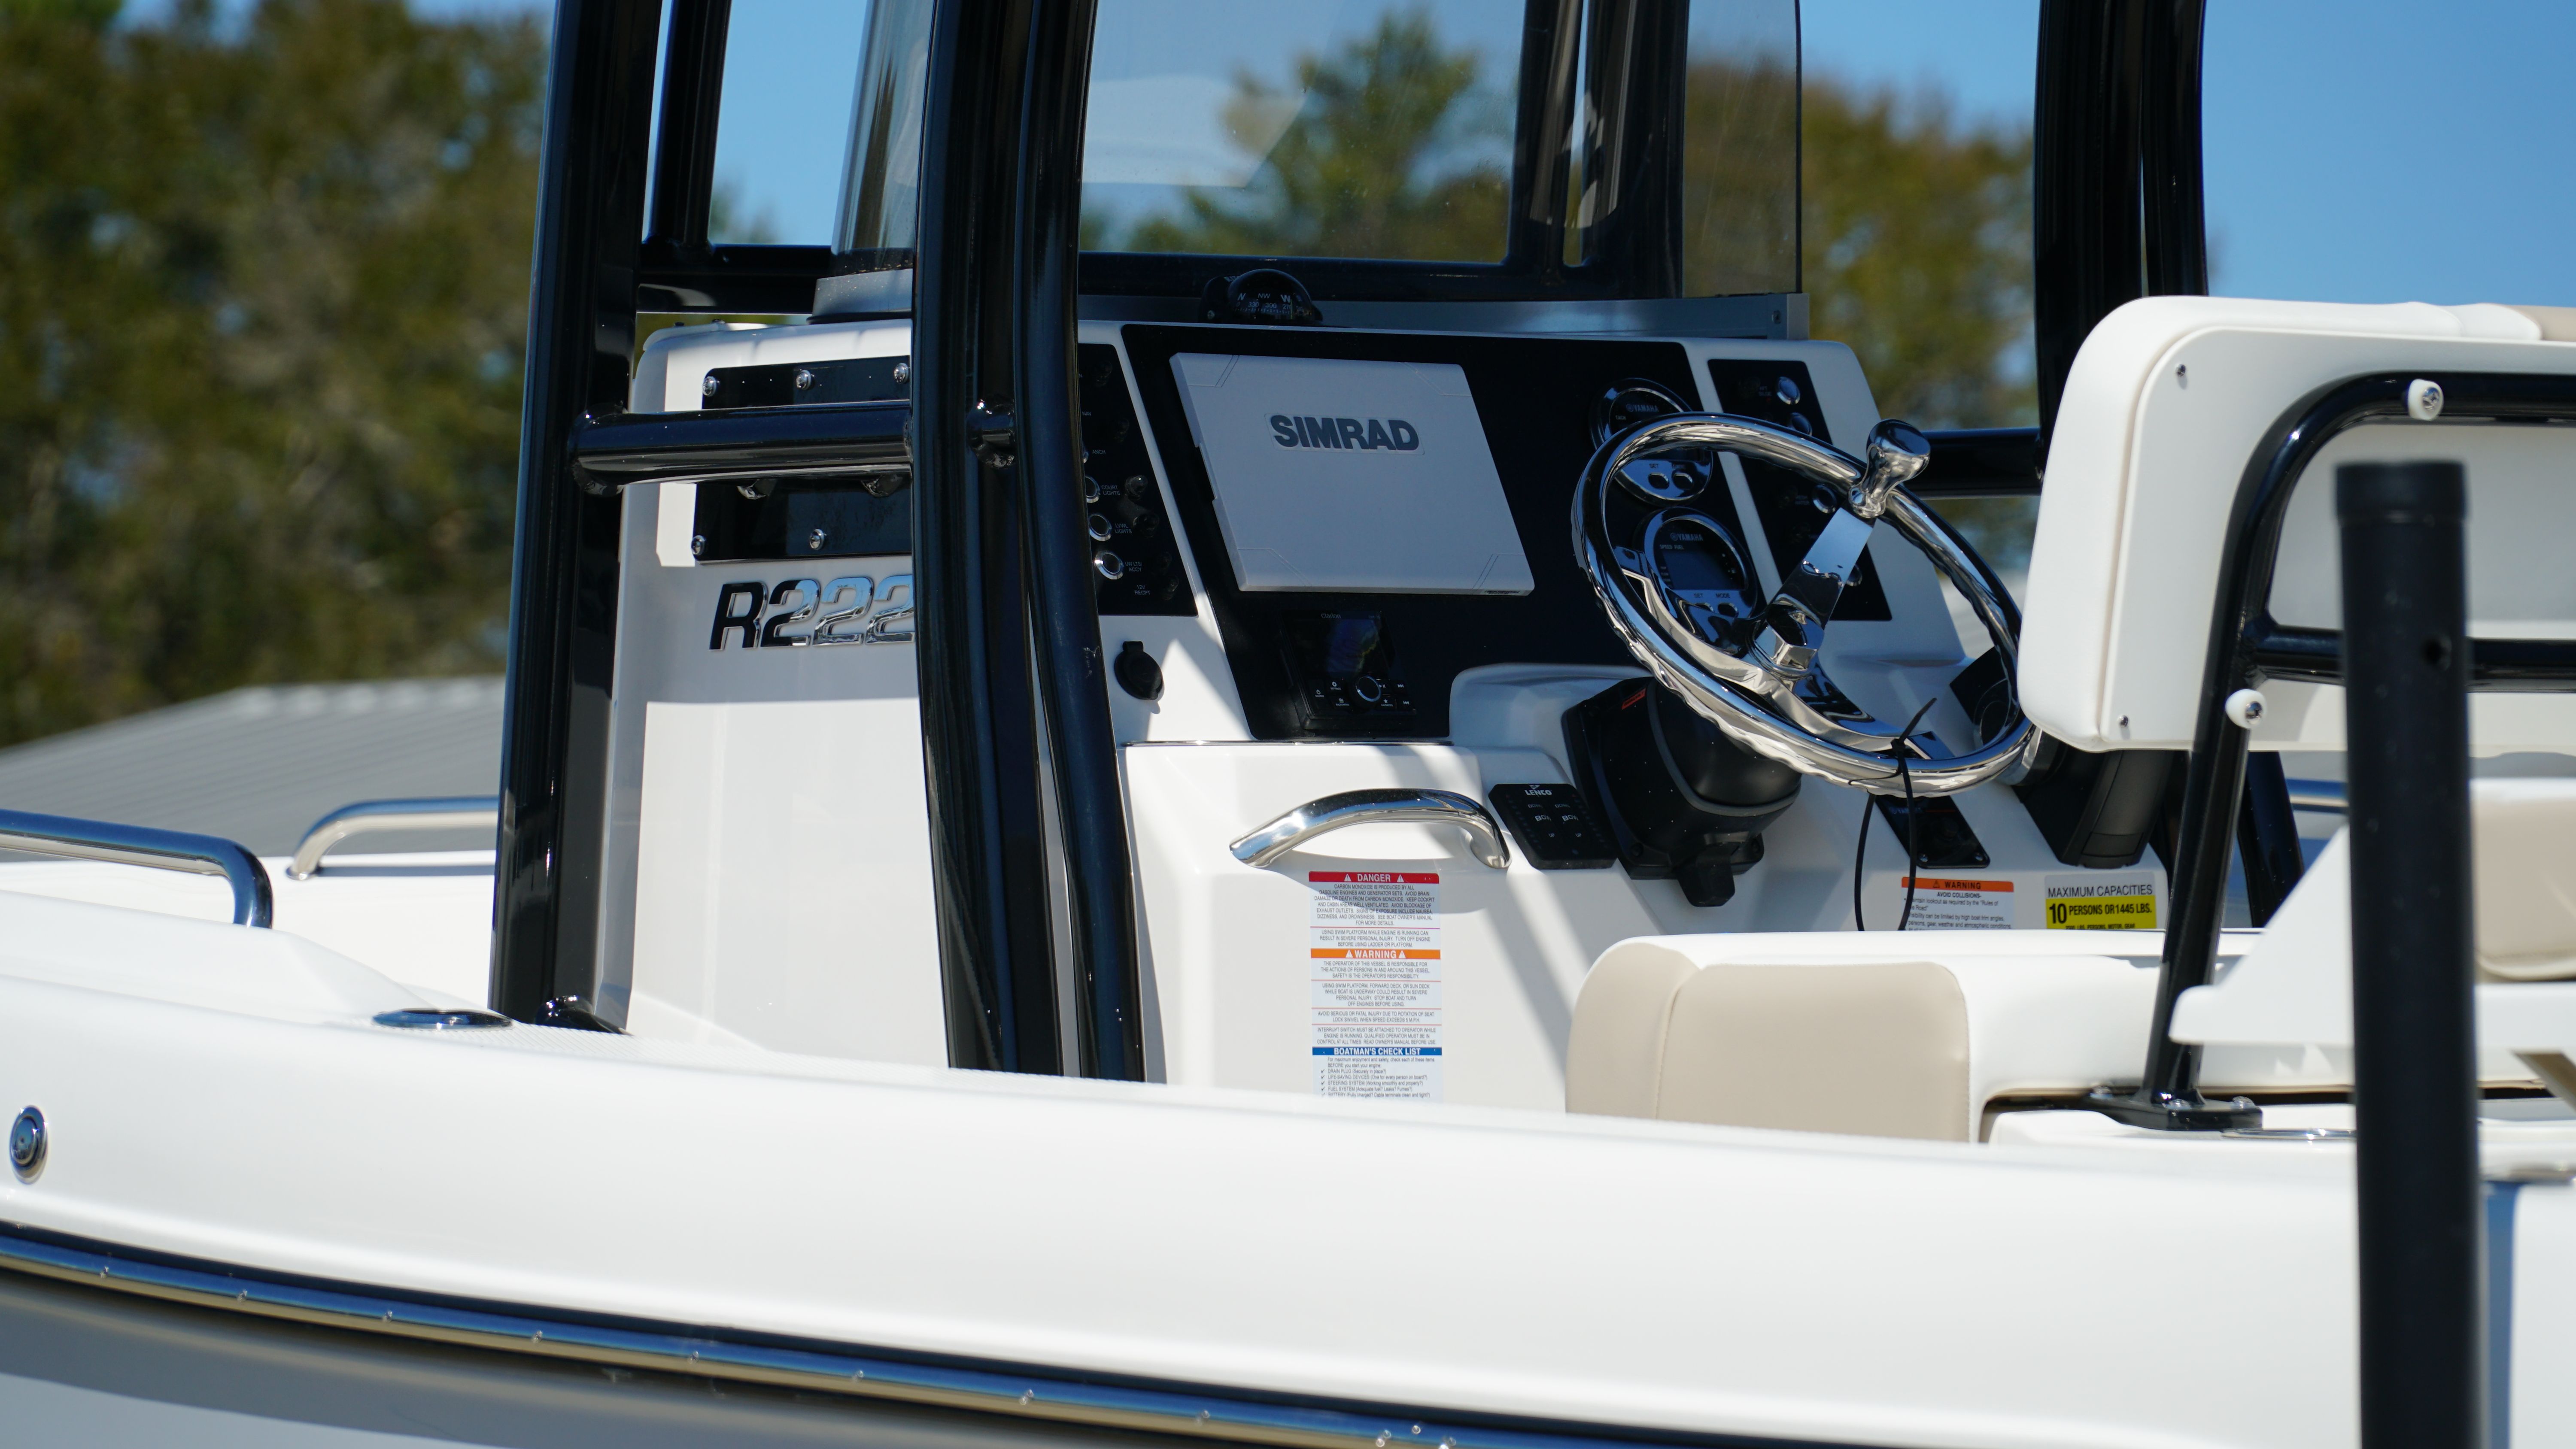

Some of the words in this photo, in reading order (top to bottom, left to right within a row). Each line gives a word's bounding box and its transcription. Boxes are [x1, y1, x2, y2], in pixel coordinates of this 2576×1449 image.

[1280, 294, 1291, 303] W
[1270, 415, 1419, 450] SIMRAD
[709, 574, 916, 651] R222
[1357, 873, 1391, 882] DANGER
[1944, 881, 1981, 889] WARNING
[2048, 887, 2094, 897] MAXIMUM
[2097, 885, 2153, 896] CAPACITIES
[2049, 903, 2067, 924] 10
[2069, 904, 2102, 915] PERSONS
[2136, 903, 2152, 913] LBS.
[1355, 950, 1396, 959] WARNING
[1334, 1047, 1376, 1055] BOATMAN'S
[1378, 1047, 1403, 1055] CHECK
[1404, 1047, 1421, 1055] LIST
